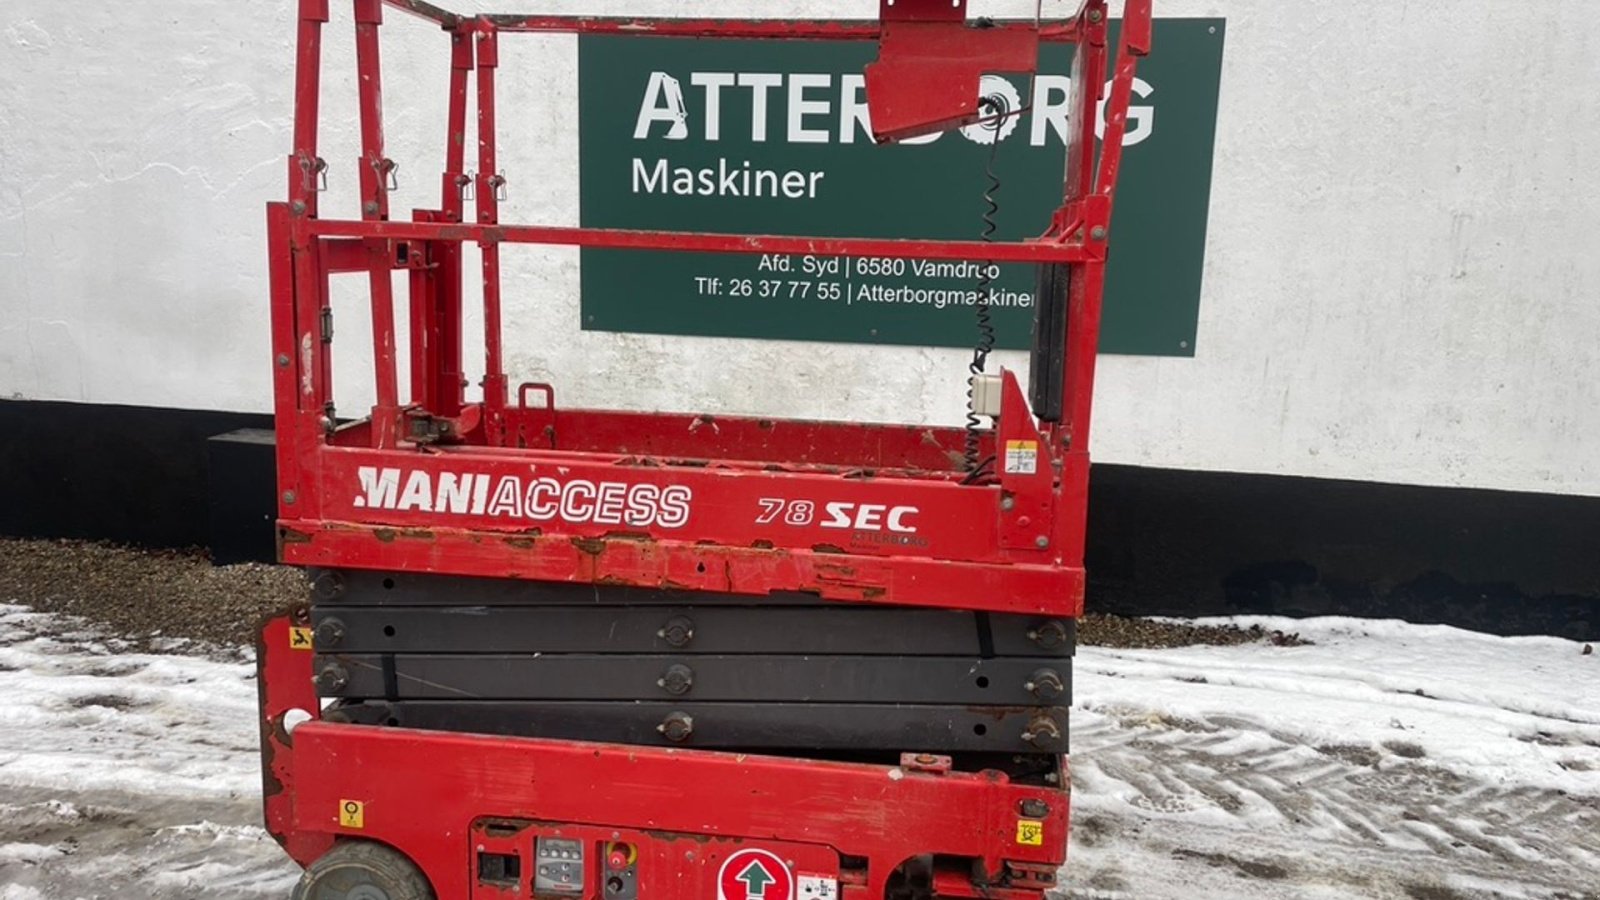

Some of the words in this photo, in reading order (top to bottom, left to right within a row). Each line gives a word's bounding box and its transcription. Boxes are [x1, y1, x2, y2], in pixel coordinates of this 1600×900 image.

[633, 71, 1155, 146] ATTERORG
[632, 157, 825, 198] Maskiner
[758, 253, 795, 272] Afd.
[802, 254, 839, 278] Syd
[856, 257, 905, 276] 6580
[695, 276, 723, 296] Tlf:
[729, 278, 753, 297] 26
[758, 279, 782, 298] 37
[788, 280, 812, 299] 77
[816, 282, 841, 300] 55
[755, 497, 815, 526] 78
[820, 502, 920, 533] SEC
